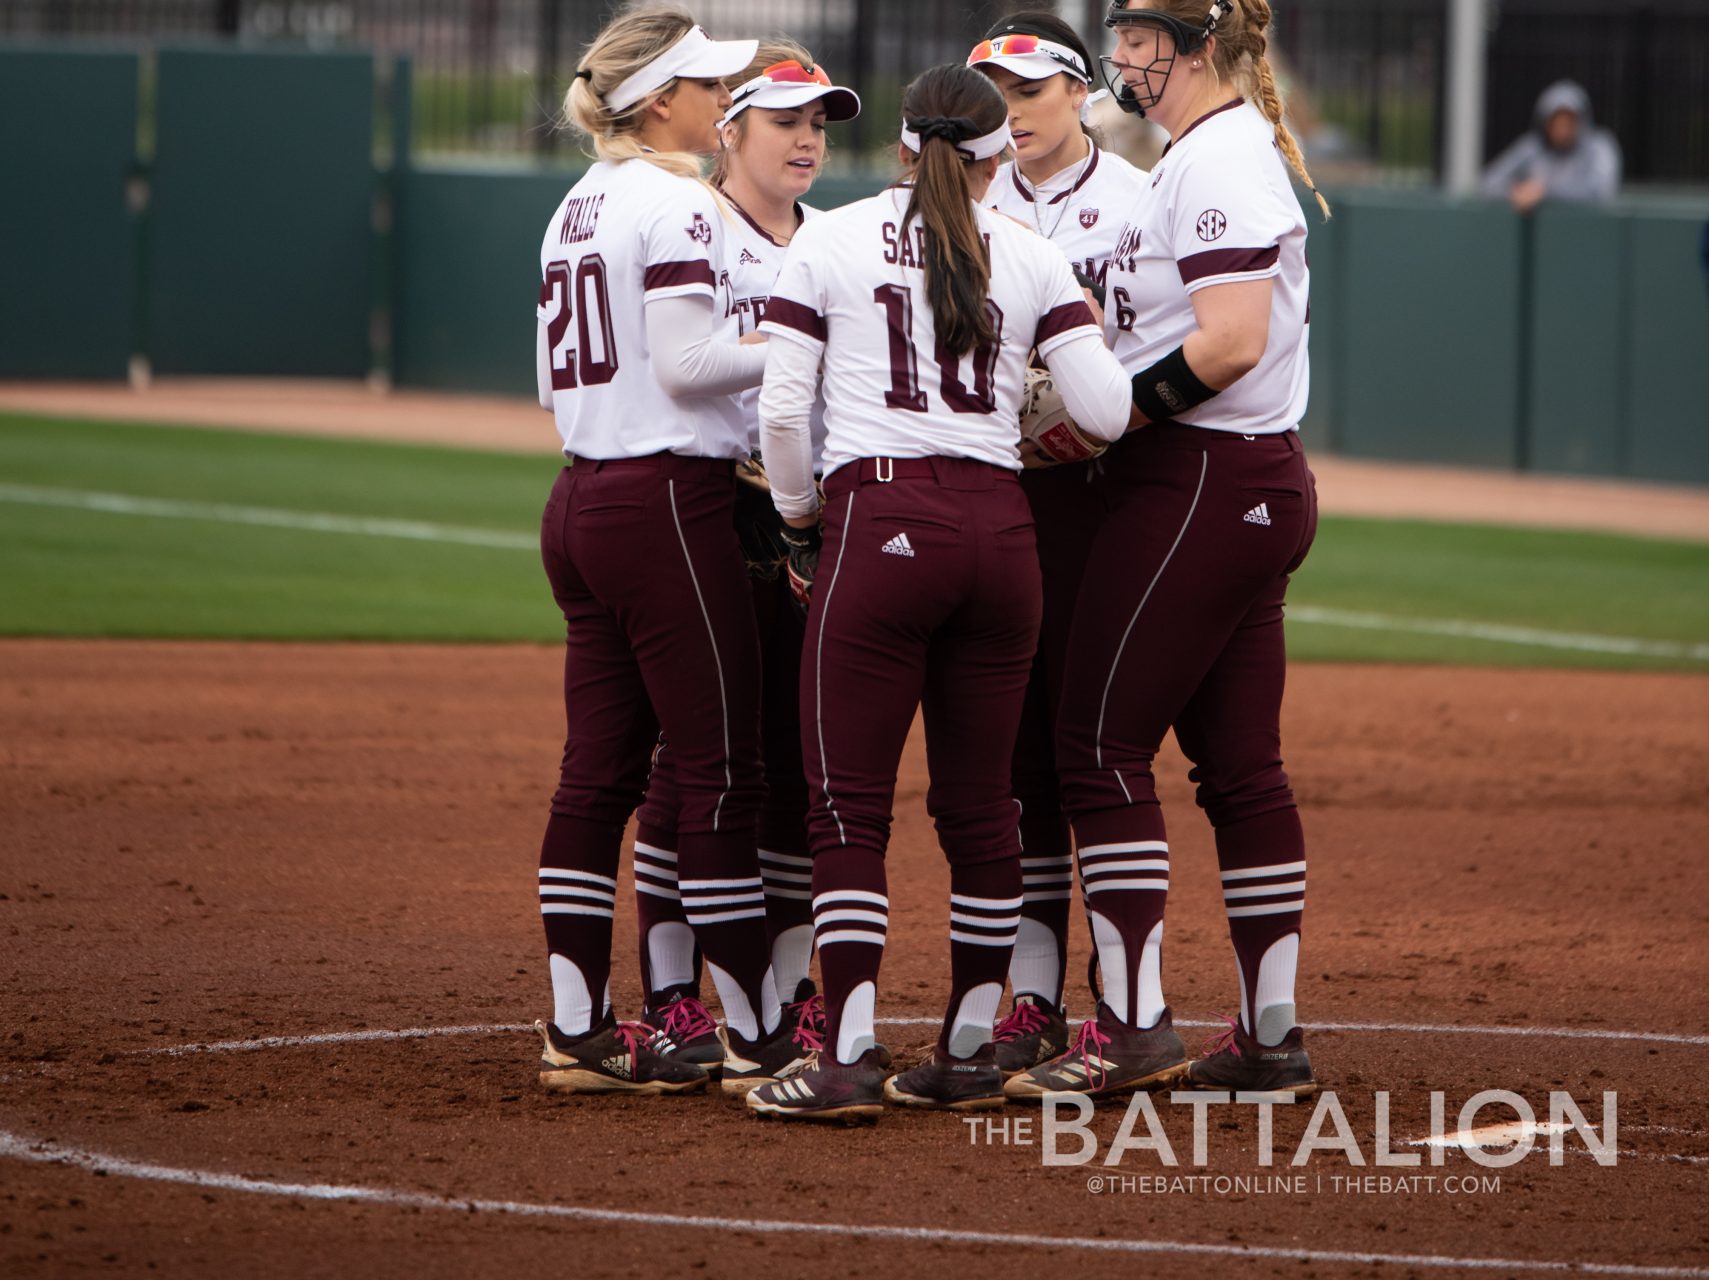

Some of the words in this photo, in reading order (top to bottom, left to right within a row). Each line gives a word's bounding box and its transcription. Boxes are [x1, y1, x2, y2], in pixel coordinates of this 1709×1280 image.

[560, 193, 605, 245] WALLS
[1081, 215, 1094, 224] 41
[1197, 210, 1225, 240] SEC
[546, 252, 619, 391] 20
[1114, 286, 1136, 332] 6
[874, 283, 1003, 415] 10
[1244, 513, 1271, 526] adidas
[882, 544, 914, 557] adidas
